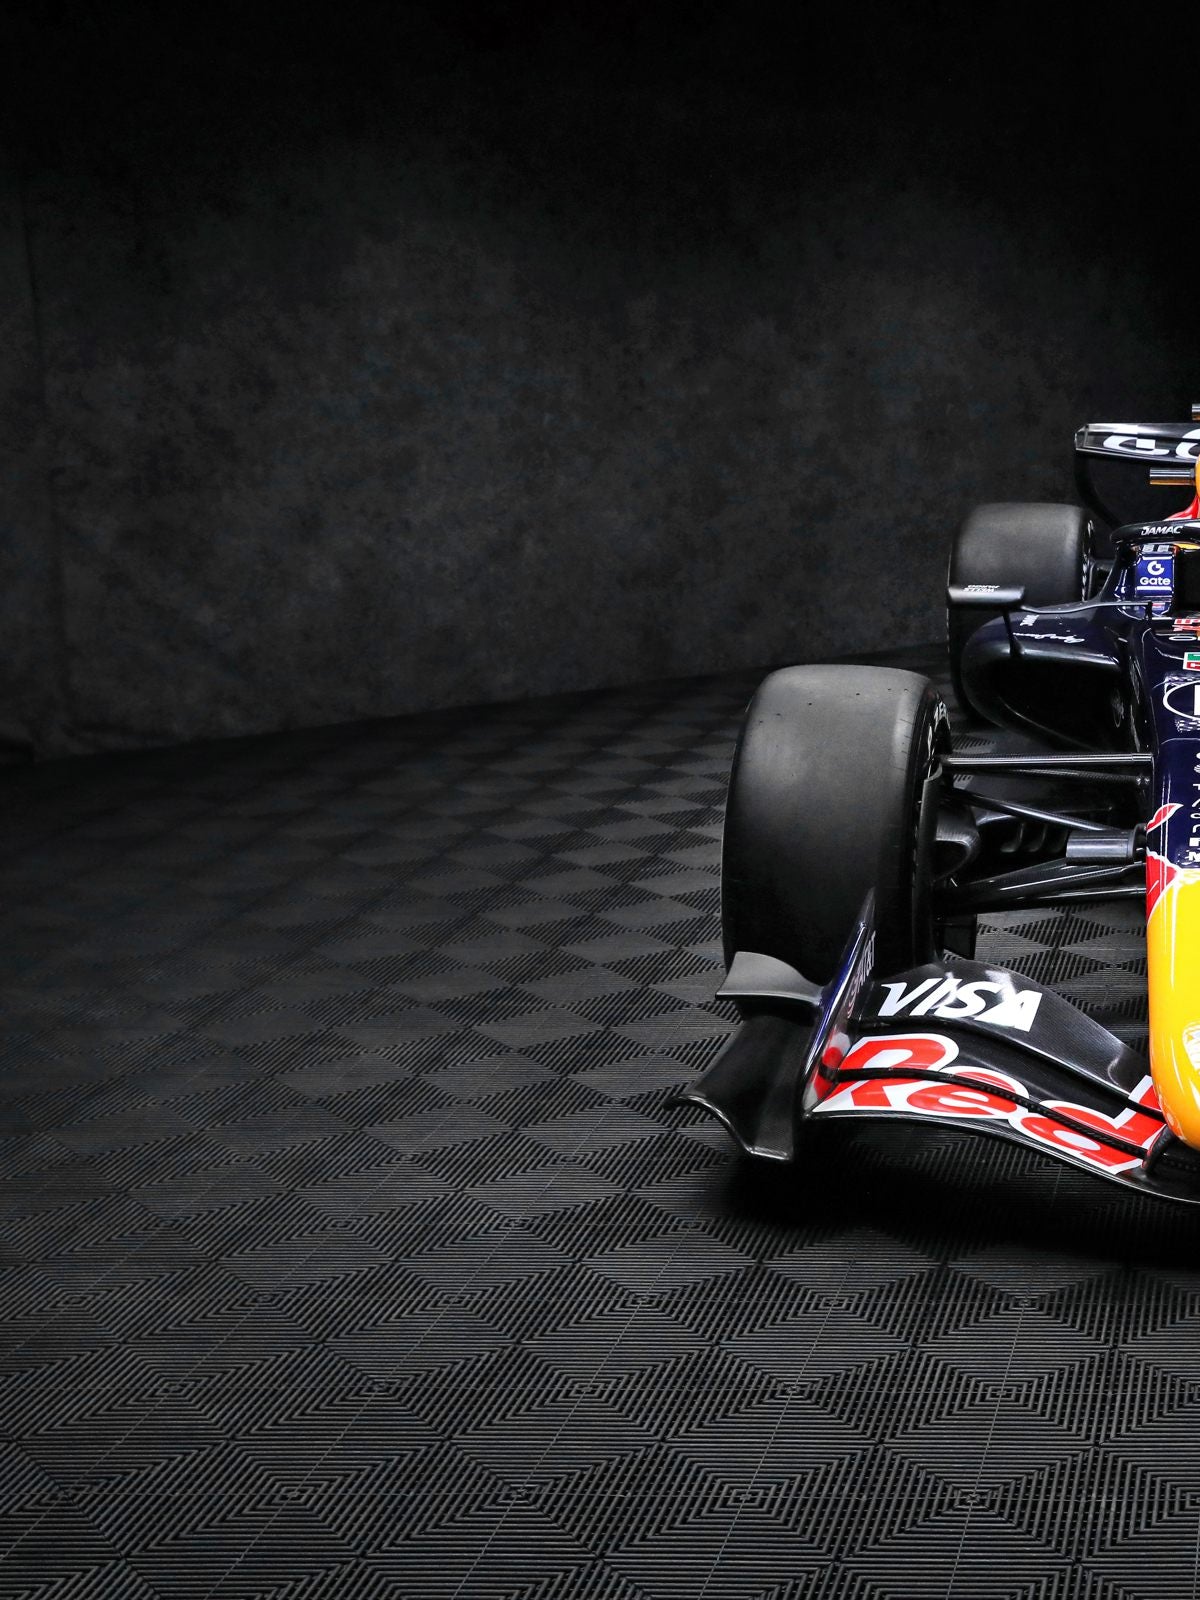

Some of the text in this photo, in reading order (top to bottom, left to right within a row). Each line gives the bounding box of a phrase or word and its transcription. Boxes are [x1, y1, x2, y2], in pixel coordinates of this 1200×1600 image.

[1139, 576, 1171, 586] Gate
[878, 977, 1042, 1033] VISA
[808, 1033, 1168, 1175] Red
